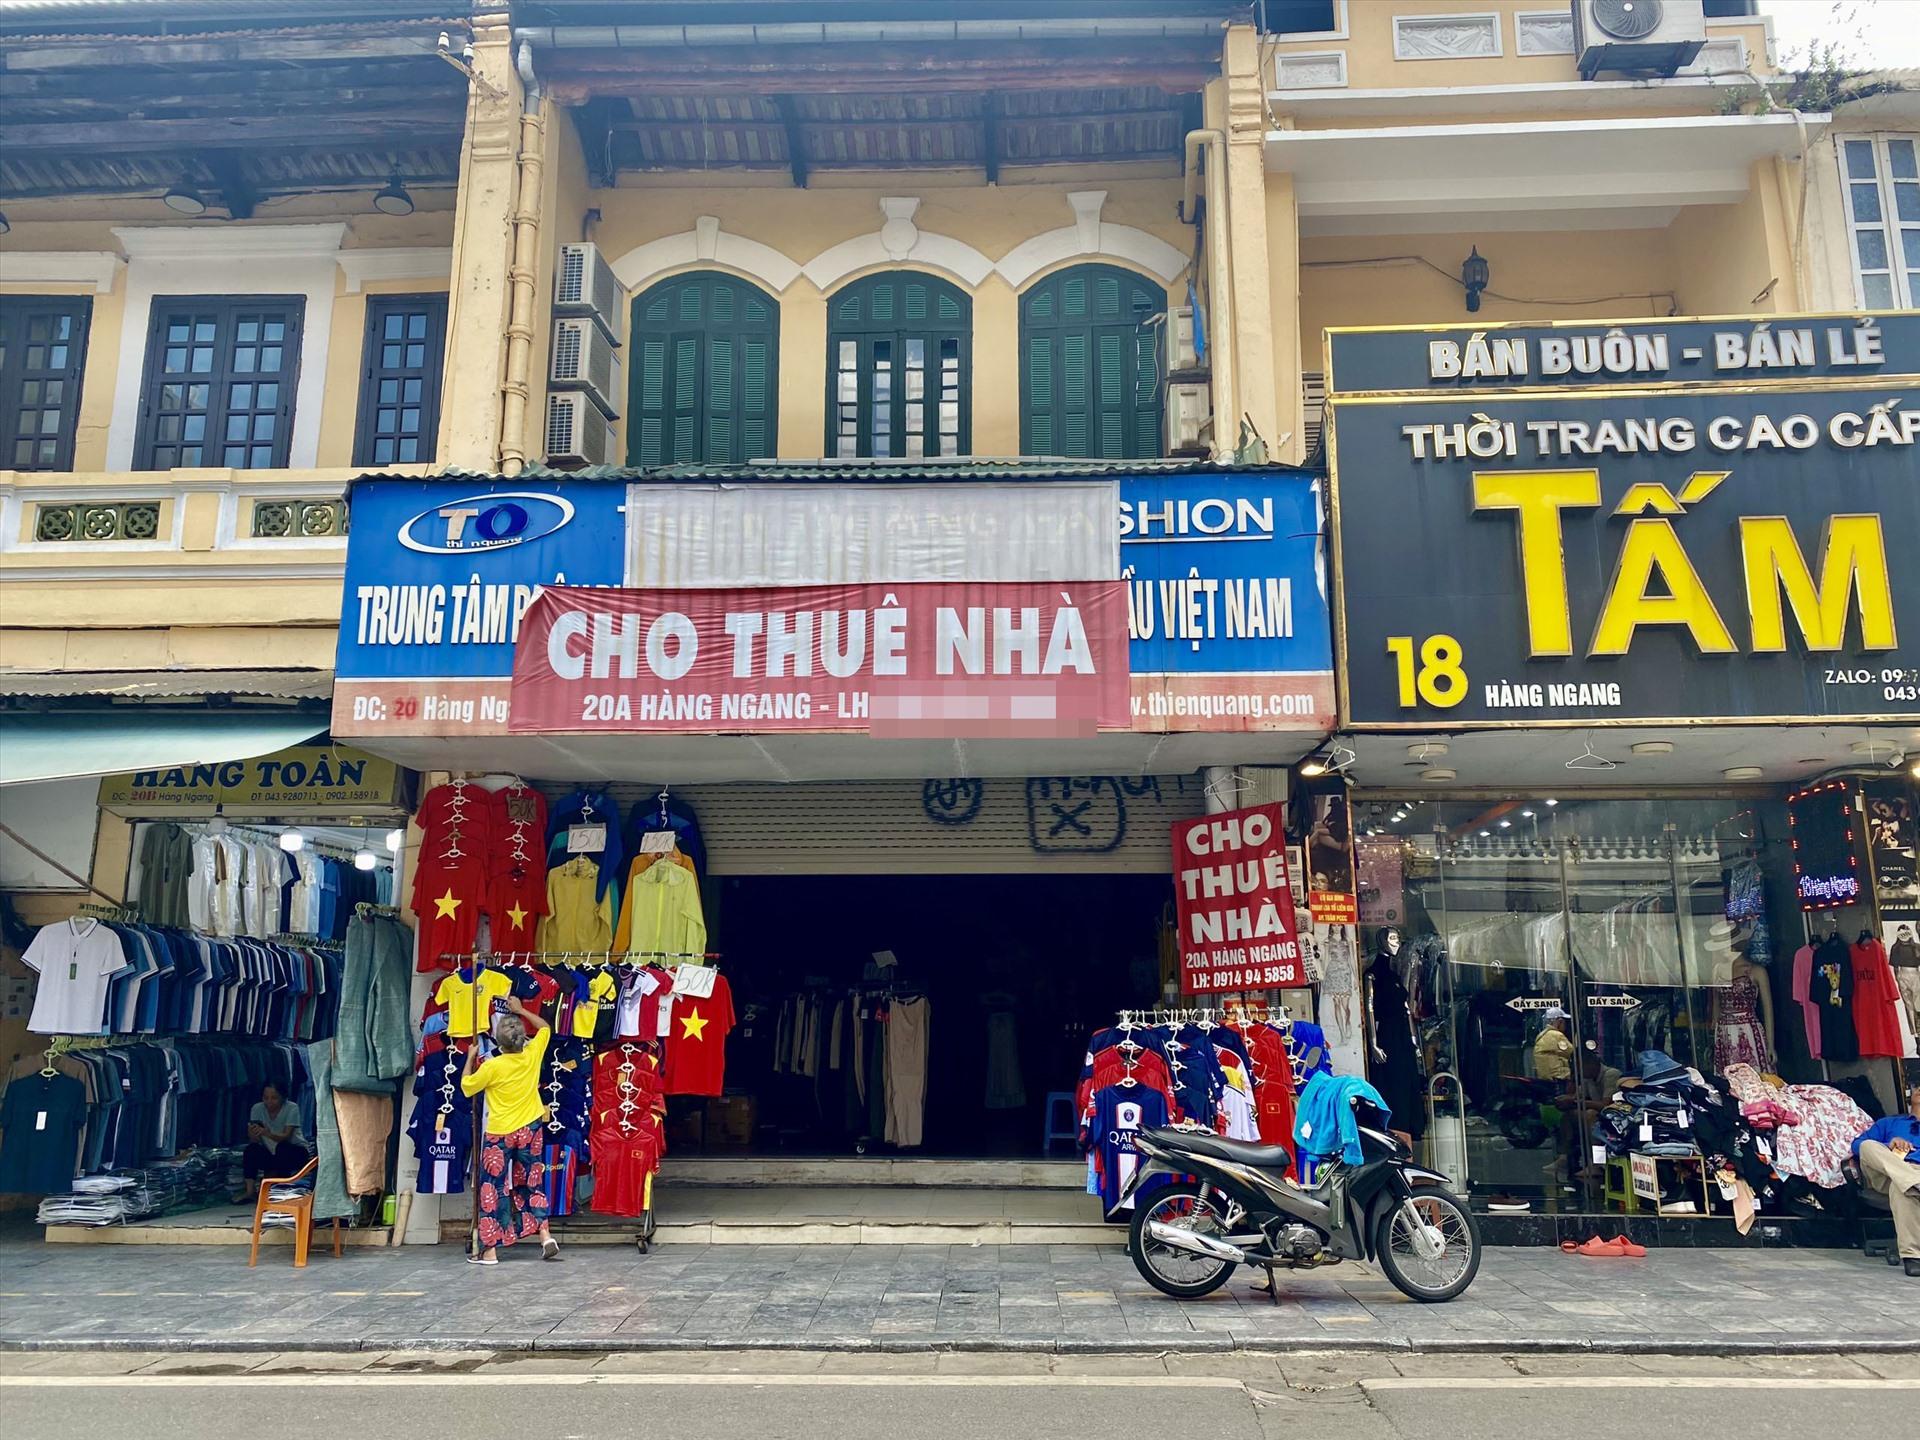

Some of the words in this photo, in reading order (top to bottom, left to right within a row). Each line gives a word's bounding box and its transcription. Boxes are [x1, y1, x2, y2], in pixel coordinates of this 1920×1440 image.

[1429, 332, 1528, 378] BÁN
[1539, 328, 1670, 376] BUÔN
[1713, 323, 1817, 370] BÁN
[1827, 317, 1887, 366] LẺ
[1402, 413, 1517, 458] THỜI
[1527, 416, 1697, 454] TRANG
[1708, 413, 1820, 451] CAO
[1472, 468, 1899, 659] TẤM
[357, 585, 447, 645] TRUNG
[449, 572, 510, 644] TÂM
[1159, 567, 1219, 651] VIỆT
[1224, 578, 1293, 639] NAM
[546, 611, 700, 680] CHO
[725, 593, 908, 679] THUÊ
[935, 591, 1097, 676] NHÀ
[1386, 633, 1470, 708] 18
[1485, 679, 1544, 708] HÀNG
[1549, 682, 1622, 708] NGANG
[1824, 669, 1877, 684] ZALO:
[353, 695, 387, 721] ĐC:
[394, 696, 417, 721] 20
[423, 694, 475, 723] Hàng
[581, 693, 632, 721] 20A
[639, 688, 713, 721] HÀNG
[720, 692, 811, 720] NGANG
[1186, 813, 1272, 856] CHO
[1181, 850, 1287, 900] THUÊ
[1191, 897, 1287, 944] NHÀ
[1185, 951, 1210, 969] 20A
[1212, 946, 1247, 967] HÀNG
[1249, 941, 1297, 964] NGANG
[1192, 973, 1211, 989] LH:
[1213, 970, 1242, 988] 0914
[1245, 968, 1262, 985] 94
[1264, 964, 1295, 984] 5858
[676, 965, 716, 994] 50K
[429, 1145, 456, 1155] QATAR
